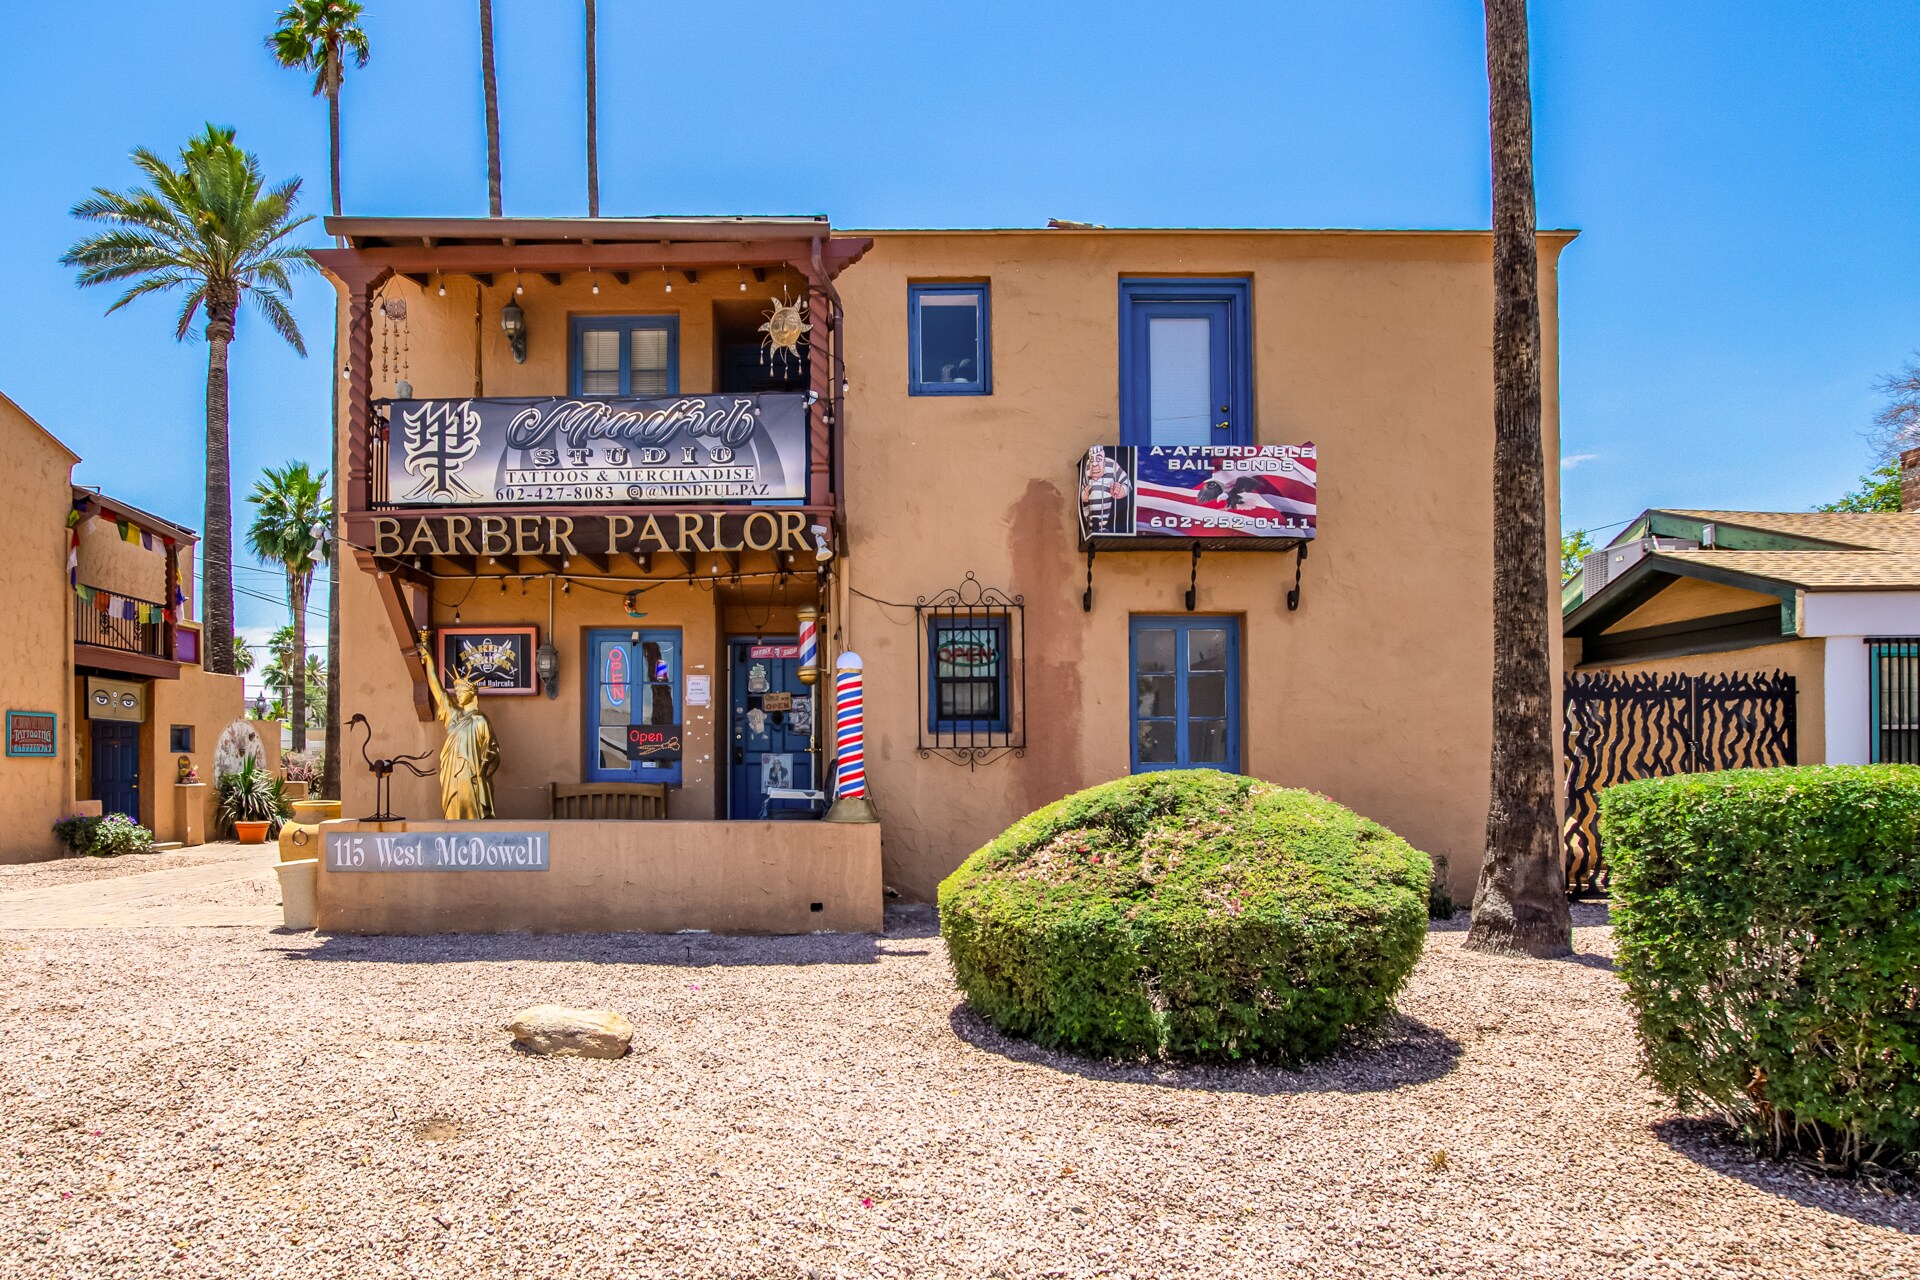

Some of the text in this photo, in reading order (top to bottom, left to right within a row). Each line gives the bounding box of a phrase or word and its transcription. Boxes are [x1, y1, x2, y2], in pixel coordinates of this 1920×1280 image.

[506, 399, 755, 450] Mindful
[533, 447, 736, 467] STUDIO
[1150, 446, 1313, 458] A-AFFORDABLE
[1167, 459, 1295, 472] BAIL BONDS
[506, 468, 754, 484] TATTOOS & MERCHANDISE
[495, 486, 615, 501] 602-427-8083
[1150, 516, 1311, 530] 602-252-0111
[370, 511, 814, 558] BARBER PARLOR
[939, 647, 993, 662] OPEN
[609, 648, 625, 700] OPEN
[765, 702, 790, 710] OPEN
[13, 729, 52, 742] TATTOOING
[629, 729, 663, 745] Open
[333, 836, 542, 867] 115 West McDowell
